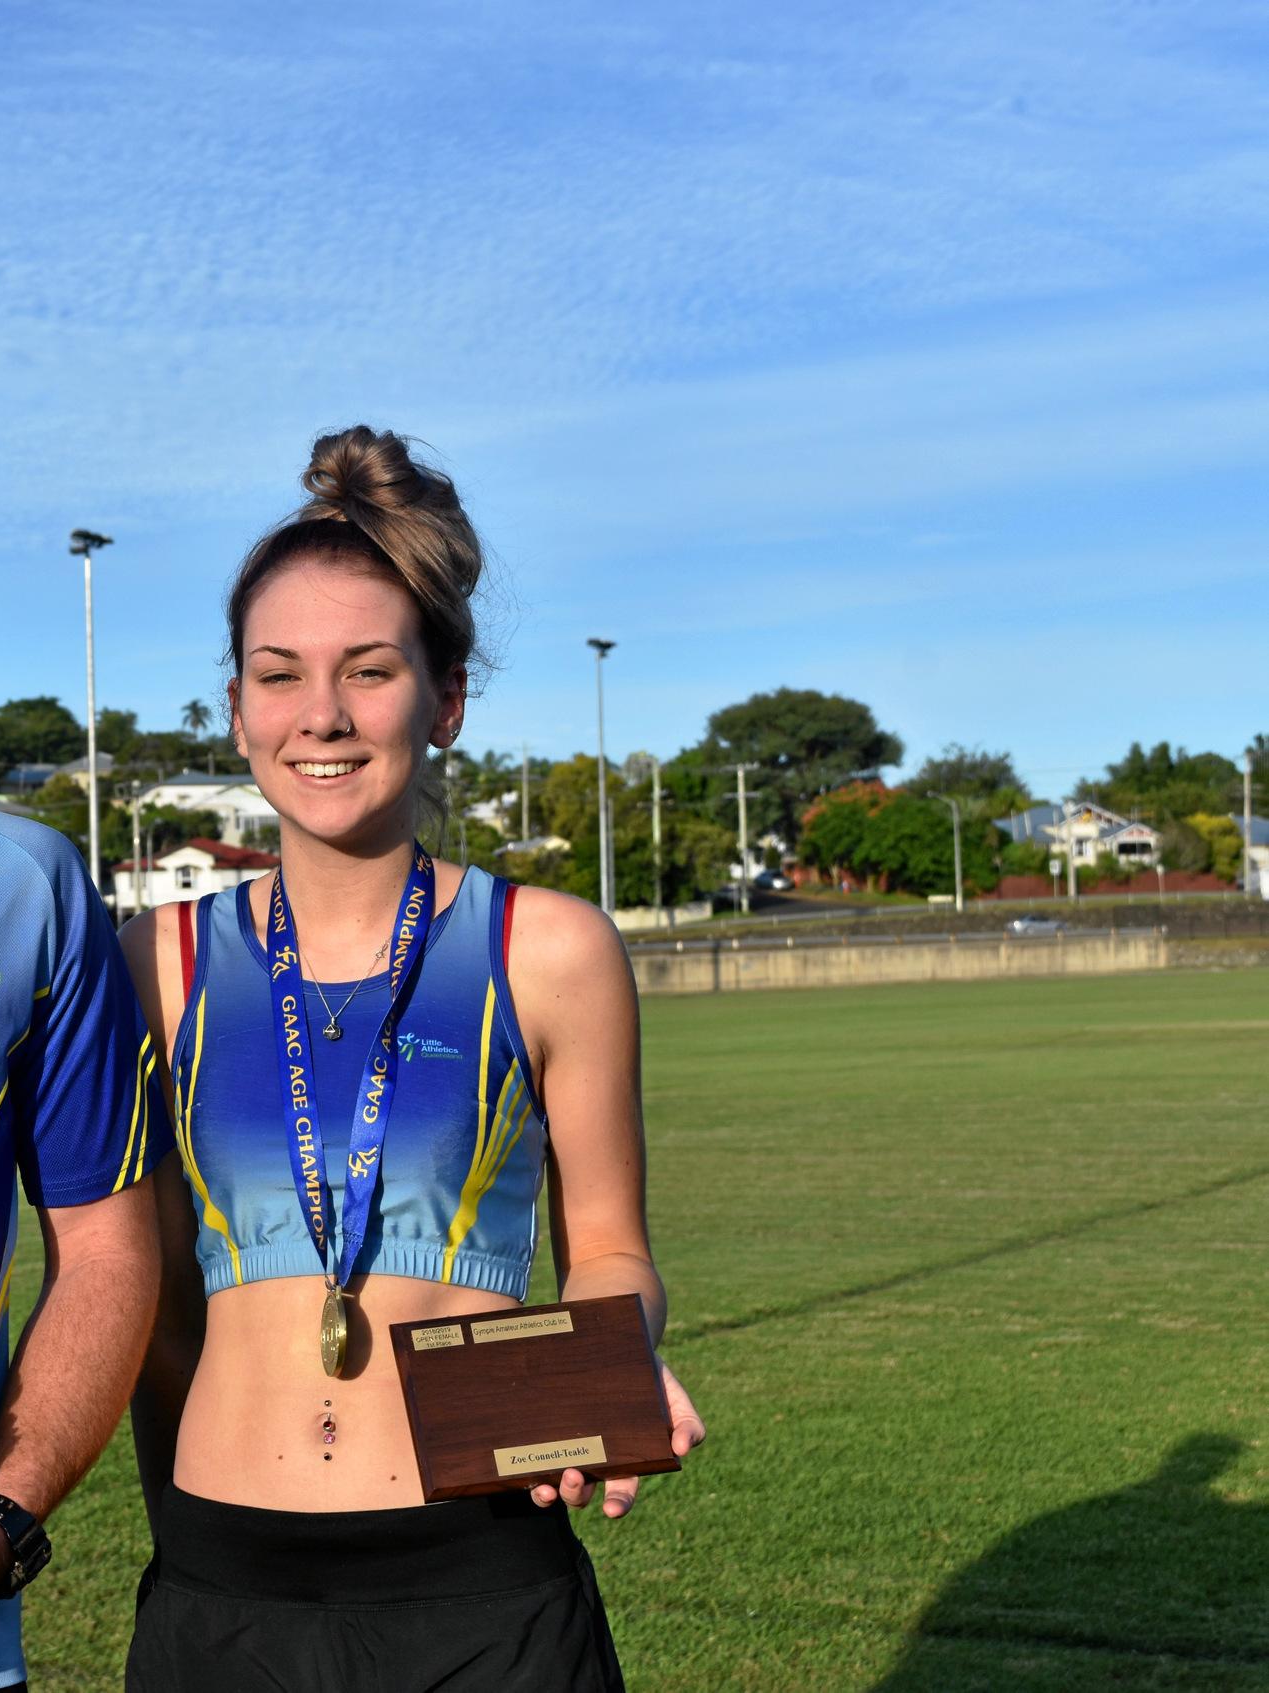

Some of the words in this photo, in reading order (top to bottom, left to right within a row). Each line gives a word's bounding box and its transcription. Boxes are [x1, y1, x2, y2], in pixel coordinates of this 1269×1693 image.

[282, 994, 302, 1058] GAAC
[421, 1038, 442, 1047] Little
[421, 1046, 459, 1054] Athletics
[289, 1063, 308, 1109] AGE
[362, 1056, 388, 1124] GAAC
[296, 1115, 327, 1252] CHAMPION
[495, 1324, 519, 1333] Amateur
[519, 1321, 543, 1330] Athletics
[543, 1318, 558, 1328] Club
[434, 1332, 460, 1341] FEMALE
[510, 1453, 526, 1465] Zoe
[528, 1445, 590, 1463] Connell-Teakle
